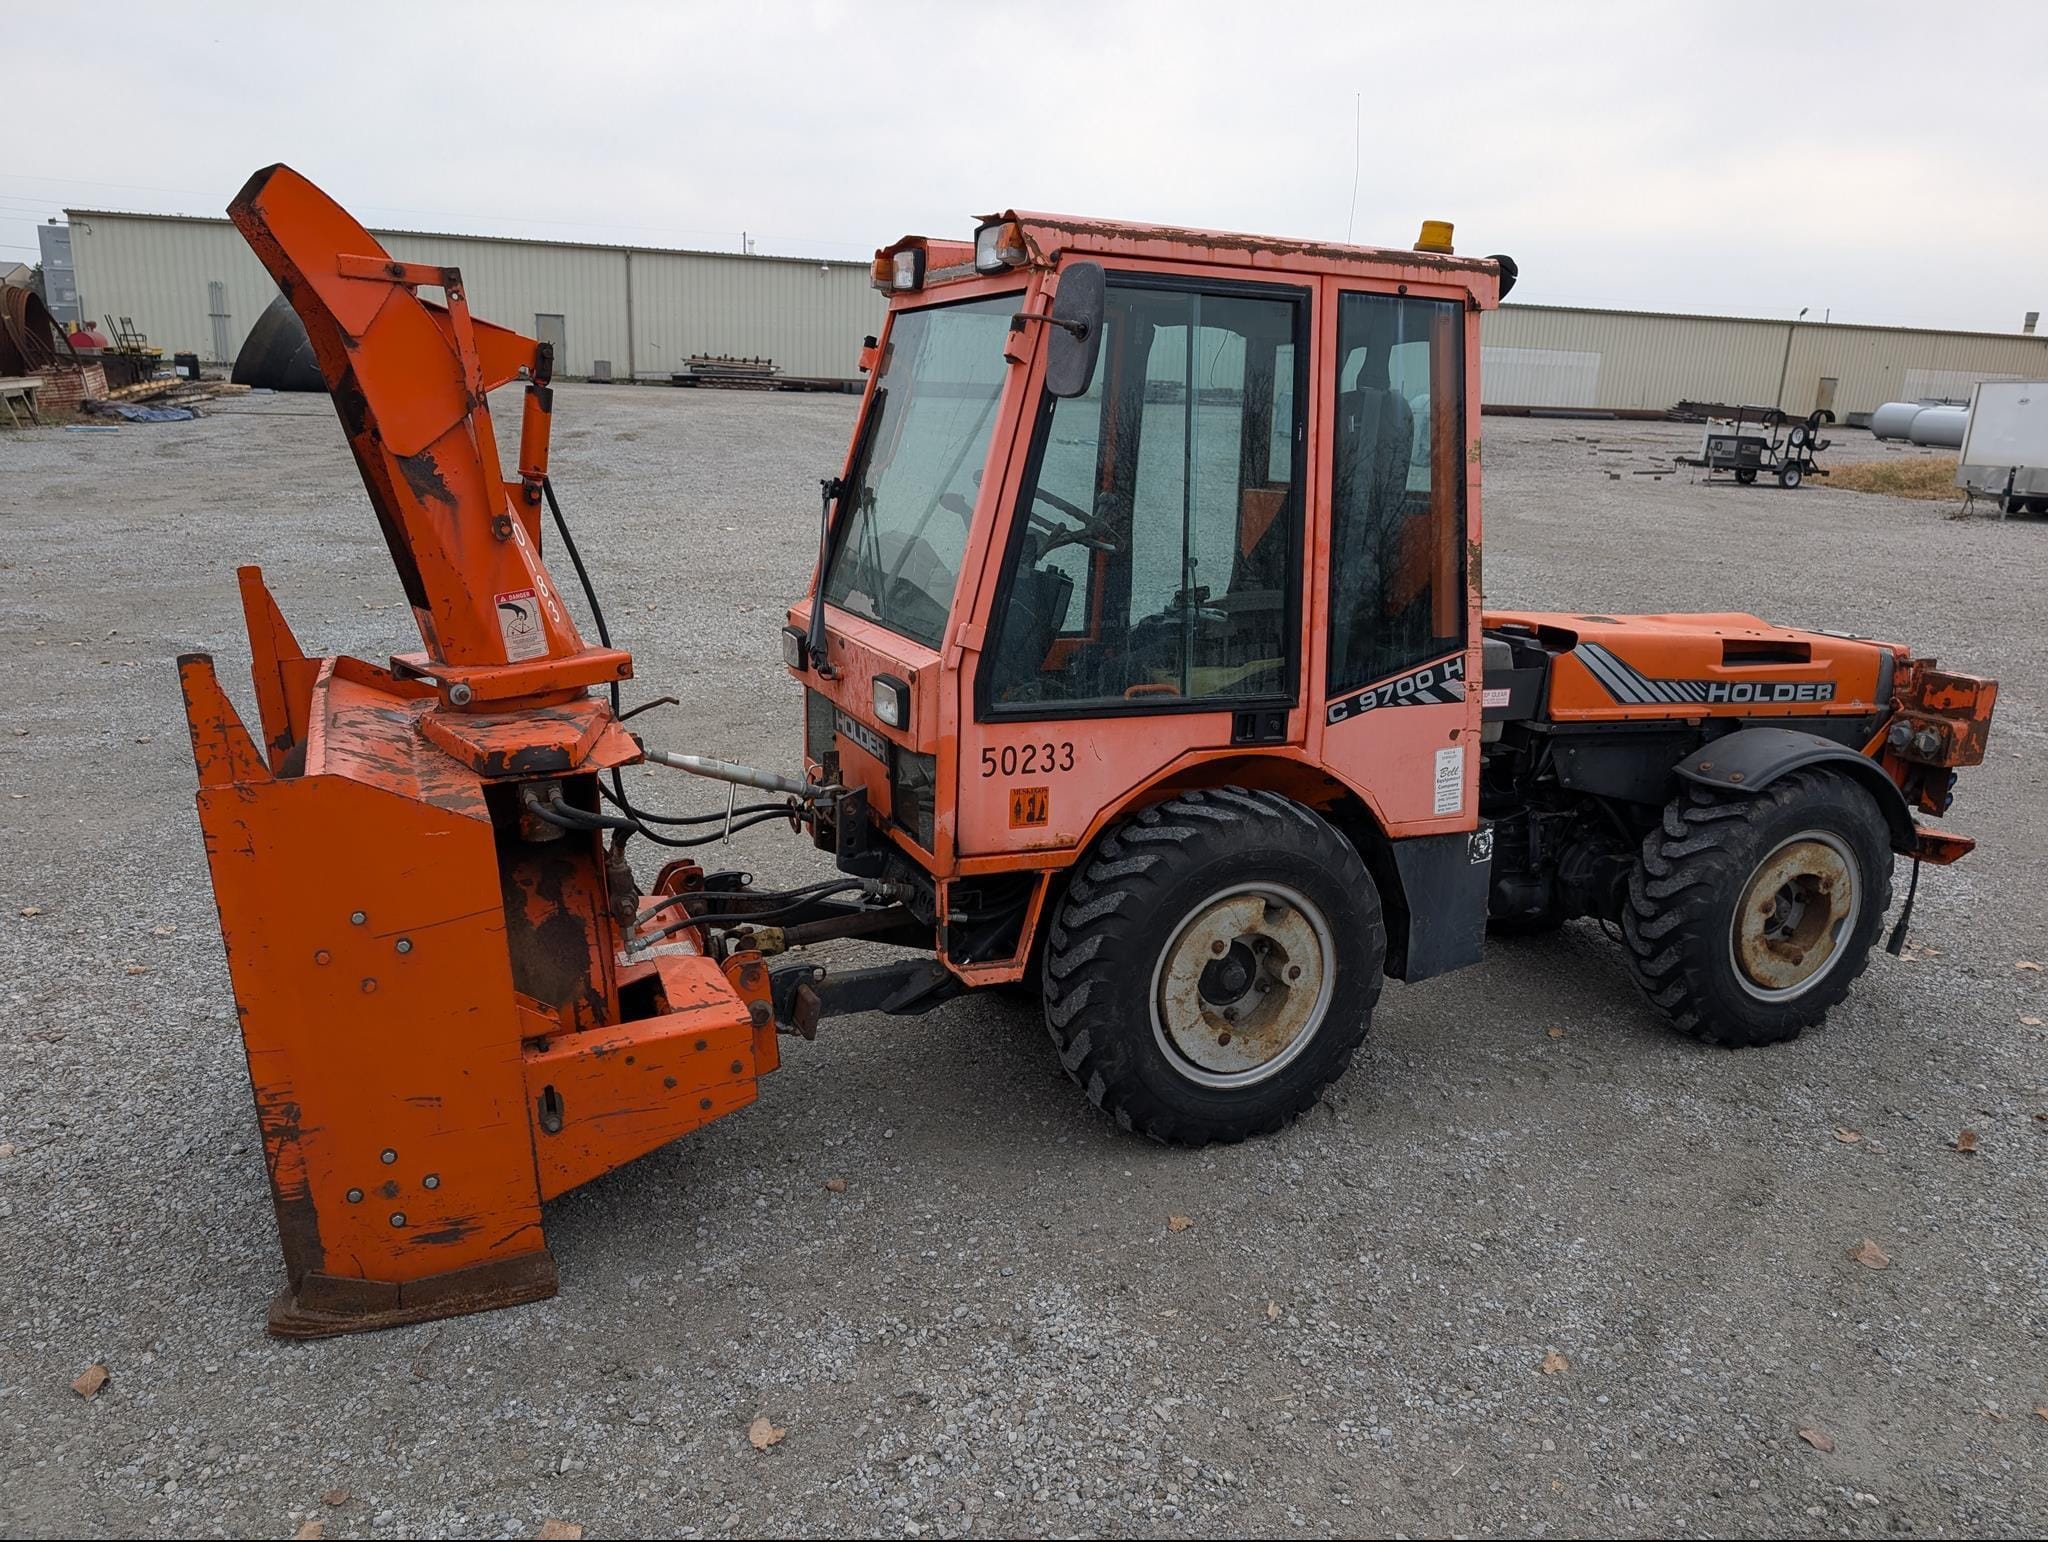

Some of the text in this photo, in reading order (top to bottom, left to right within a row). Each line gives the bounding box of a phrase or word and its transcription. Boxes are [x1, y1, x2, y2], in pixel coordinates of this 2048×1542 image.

[508, 508, 560, 623] 0183
[508, 591, 531, 601] DANGER
[1328, 657, 1464, 723] C 9700 H
[1707, 683, 1833, 702] HOLDER
[835, 709, 887, 763] HOLDER
[981, 742, 1075, 777] 50233
[1439, 766, 1460, 778] Bell
